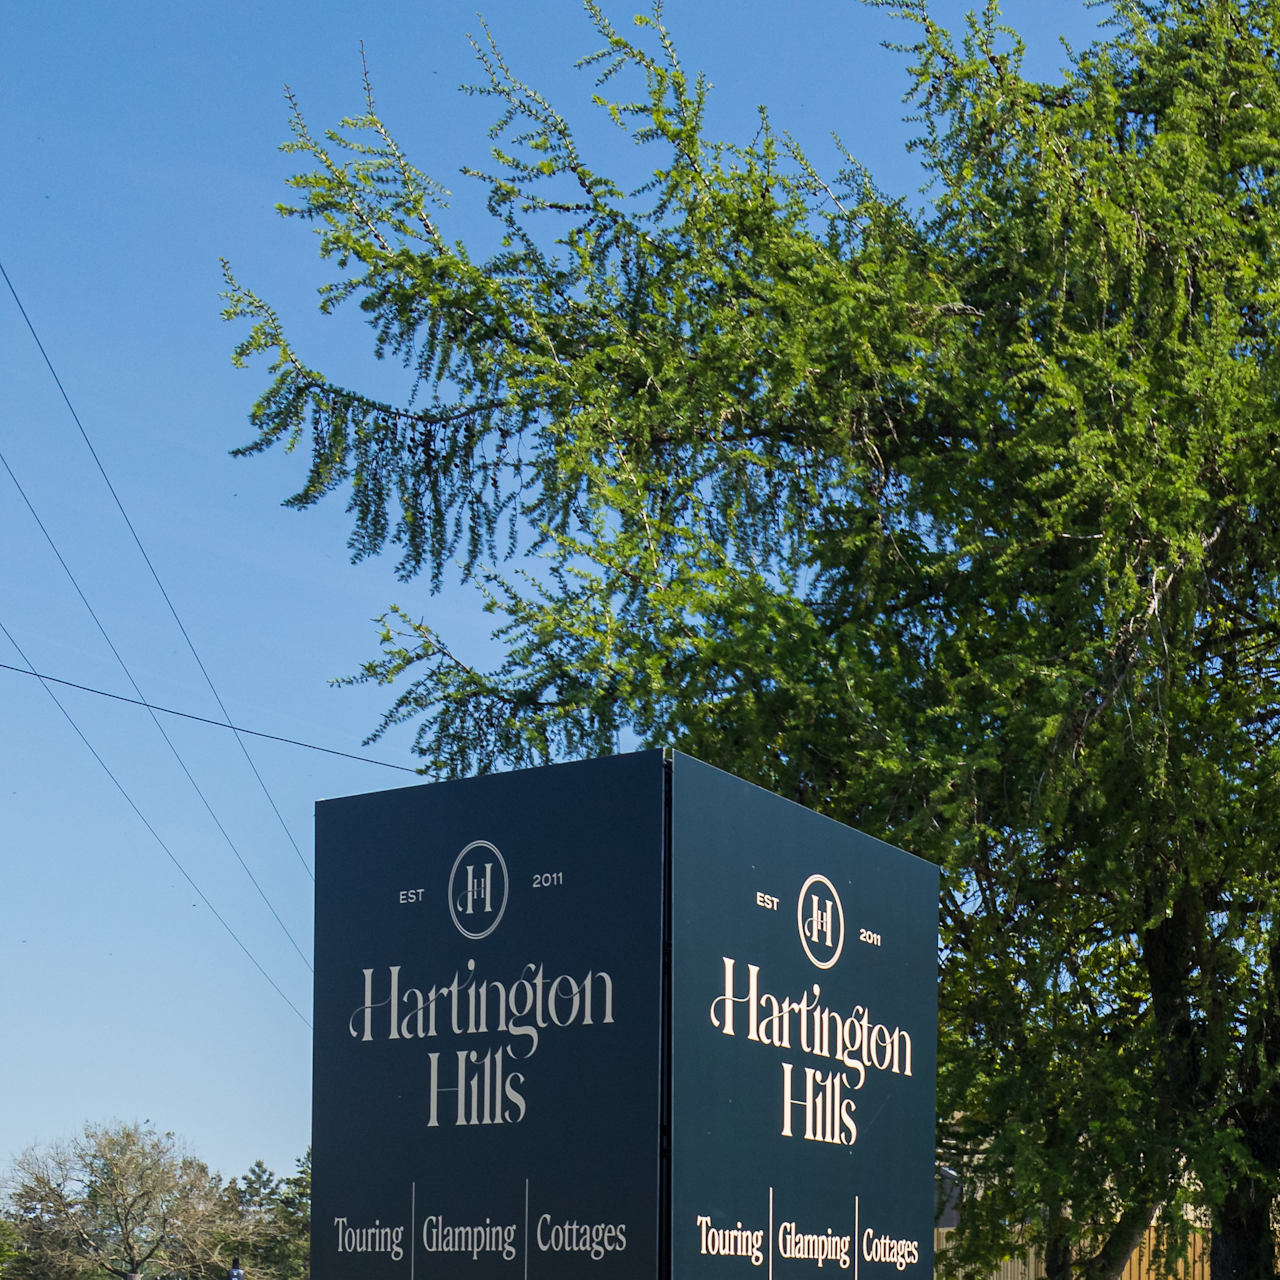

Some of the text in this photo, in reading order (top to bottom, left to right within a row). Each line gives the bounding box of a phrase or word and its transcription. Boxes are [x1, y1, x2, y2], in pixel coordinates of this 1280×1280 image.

[399, 888, 425, 904] EST
[532, 871, 564, 888] 2011
[756, 891, 780, 911] EST
[859, 928, 882, 947] 2011
[348, 958, 615, 1060] Hartington
[709, 956, 913, 1090] Hartington
[426, 1044, 528, 1127] Hills
[781, 1061, 858, 1146] Hills
[333, 1213, 627, 1262] Touring Glamping Cottages
[696, 1215, 919, 1271] Touring Glamping Cottages
